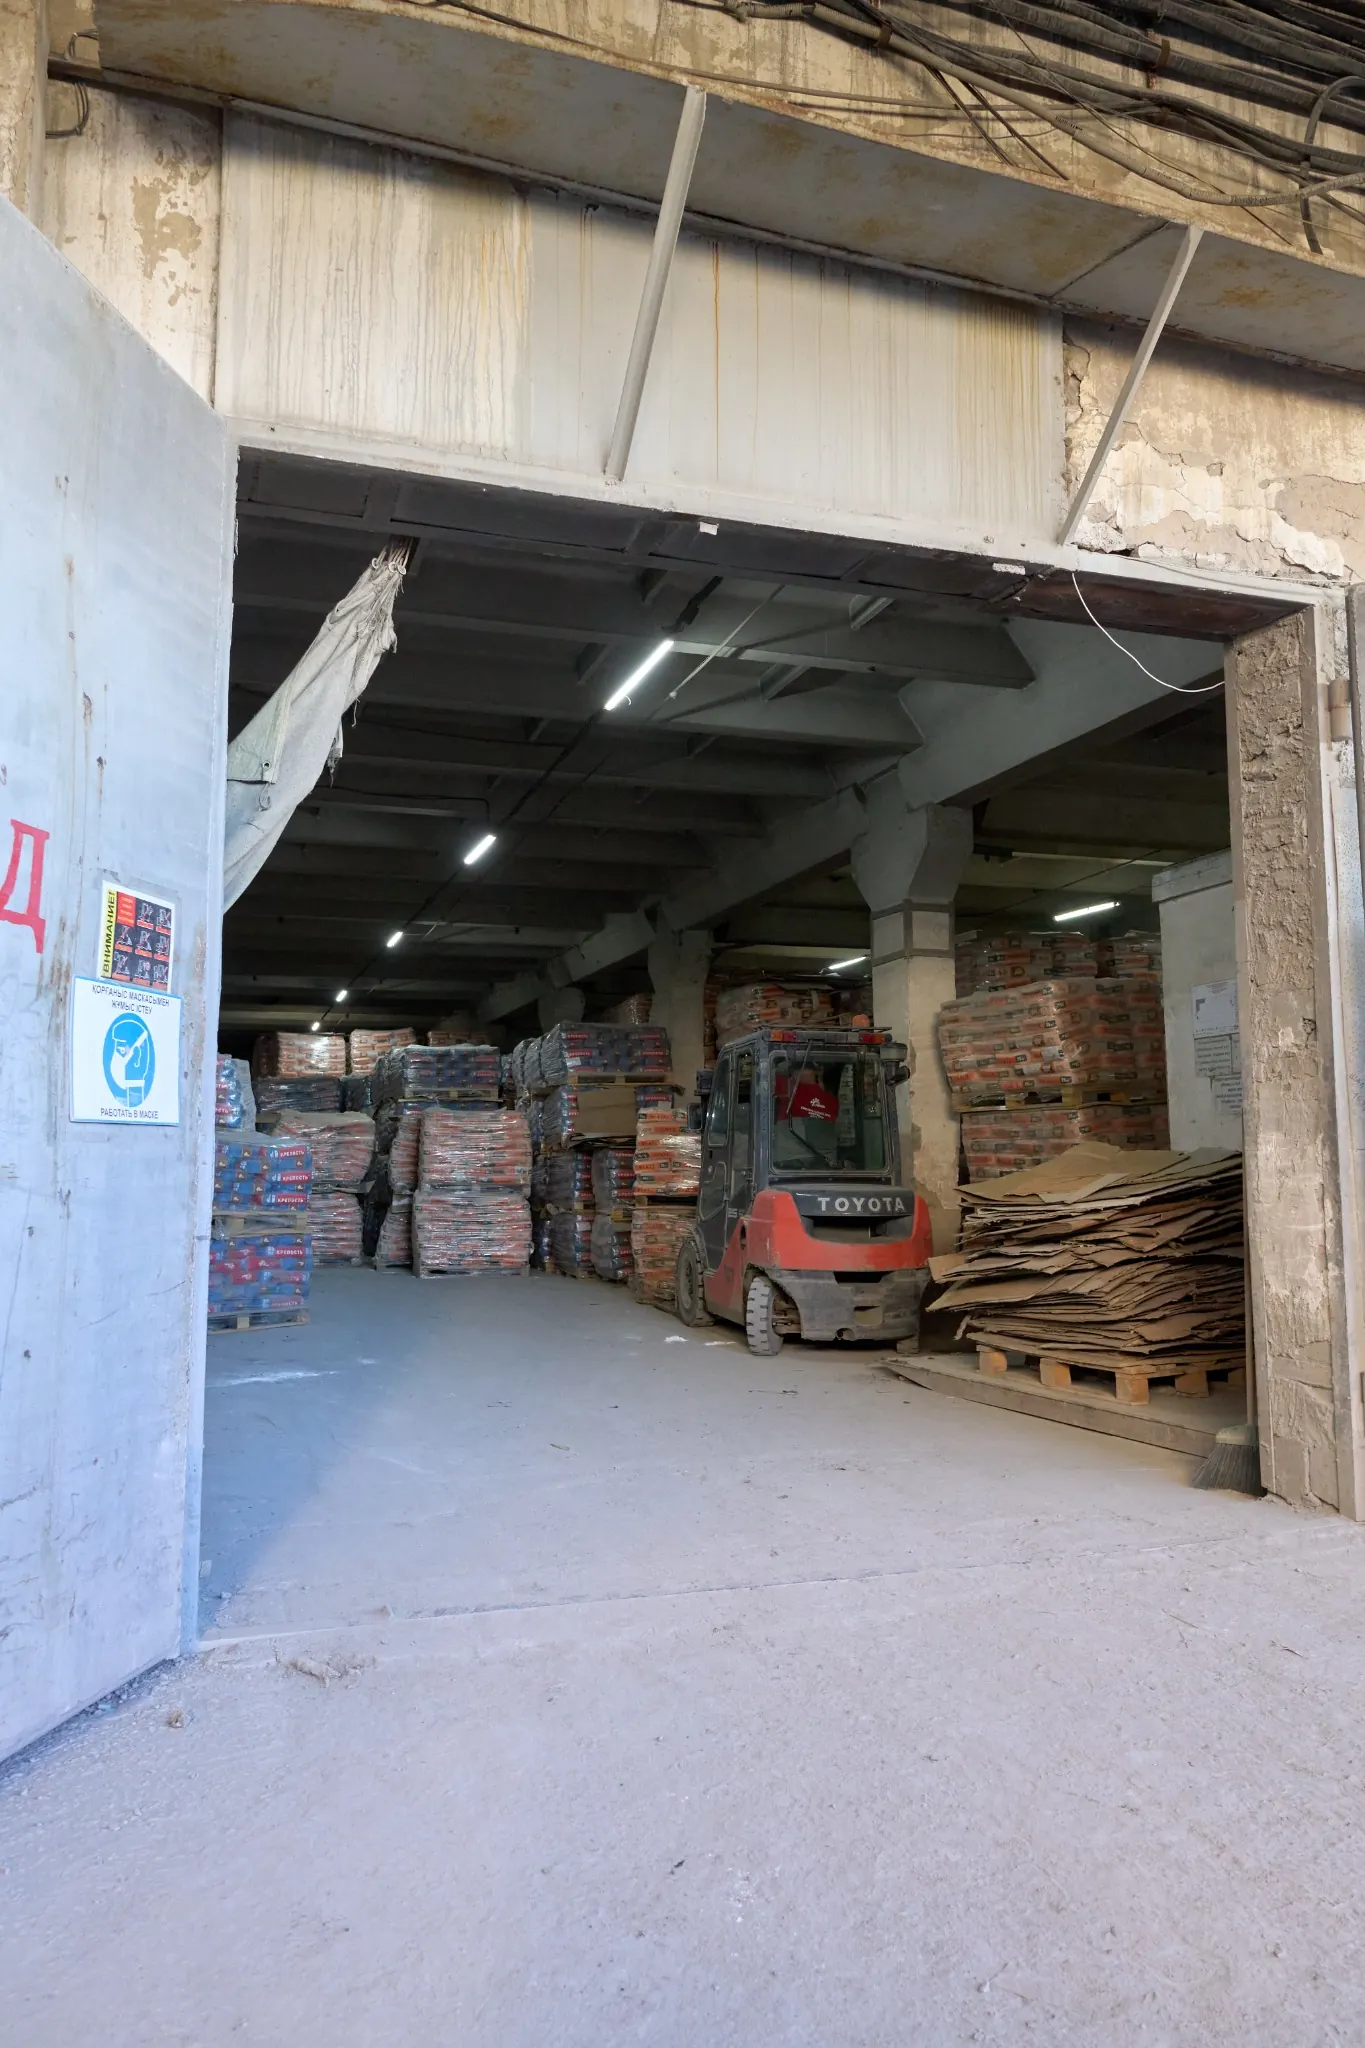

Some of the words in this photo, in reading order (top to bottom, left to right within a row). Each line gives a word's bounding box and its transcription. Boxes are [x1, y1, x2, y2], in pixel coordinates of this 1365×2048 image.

[0, 818, 50, 954] Д
[103, 891, 116, 973] ВНИМАНИЕ!
[92, 984, 128, 999] ҚОРҒАНЫС
[129, 991, 170, 1007] МАСКАСЫМЕН
[100, 1107, 133, 1118] РАБОТАТЬ
[133, 1109, 139, 1118] В
[139, 1109, 159, 1120] МАСКЕ
[817, 1197, 905, 1212] TOYOTA
